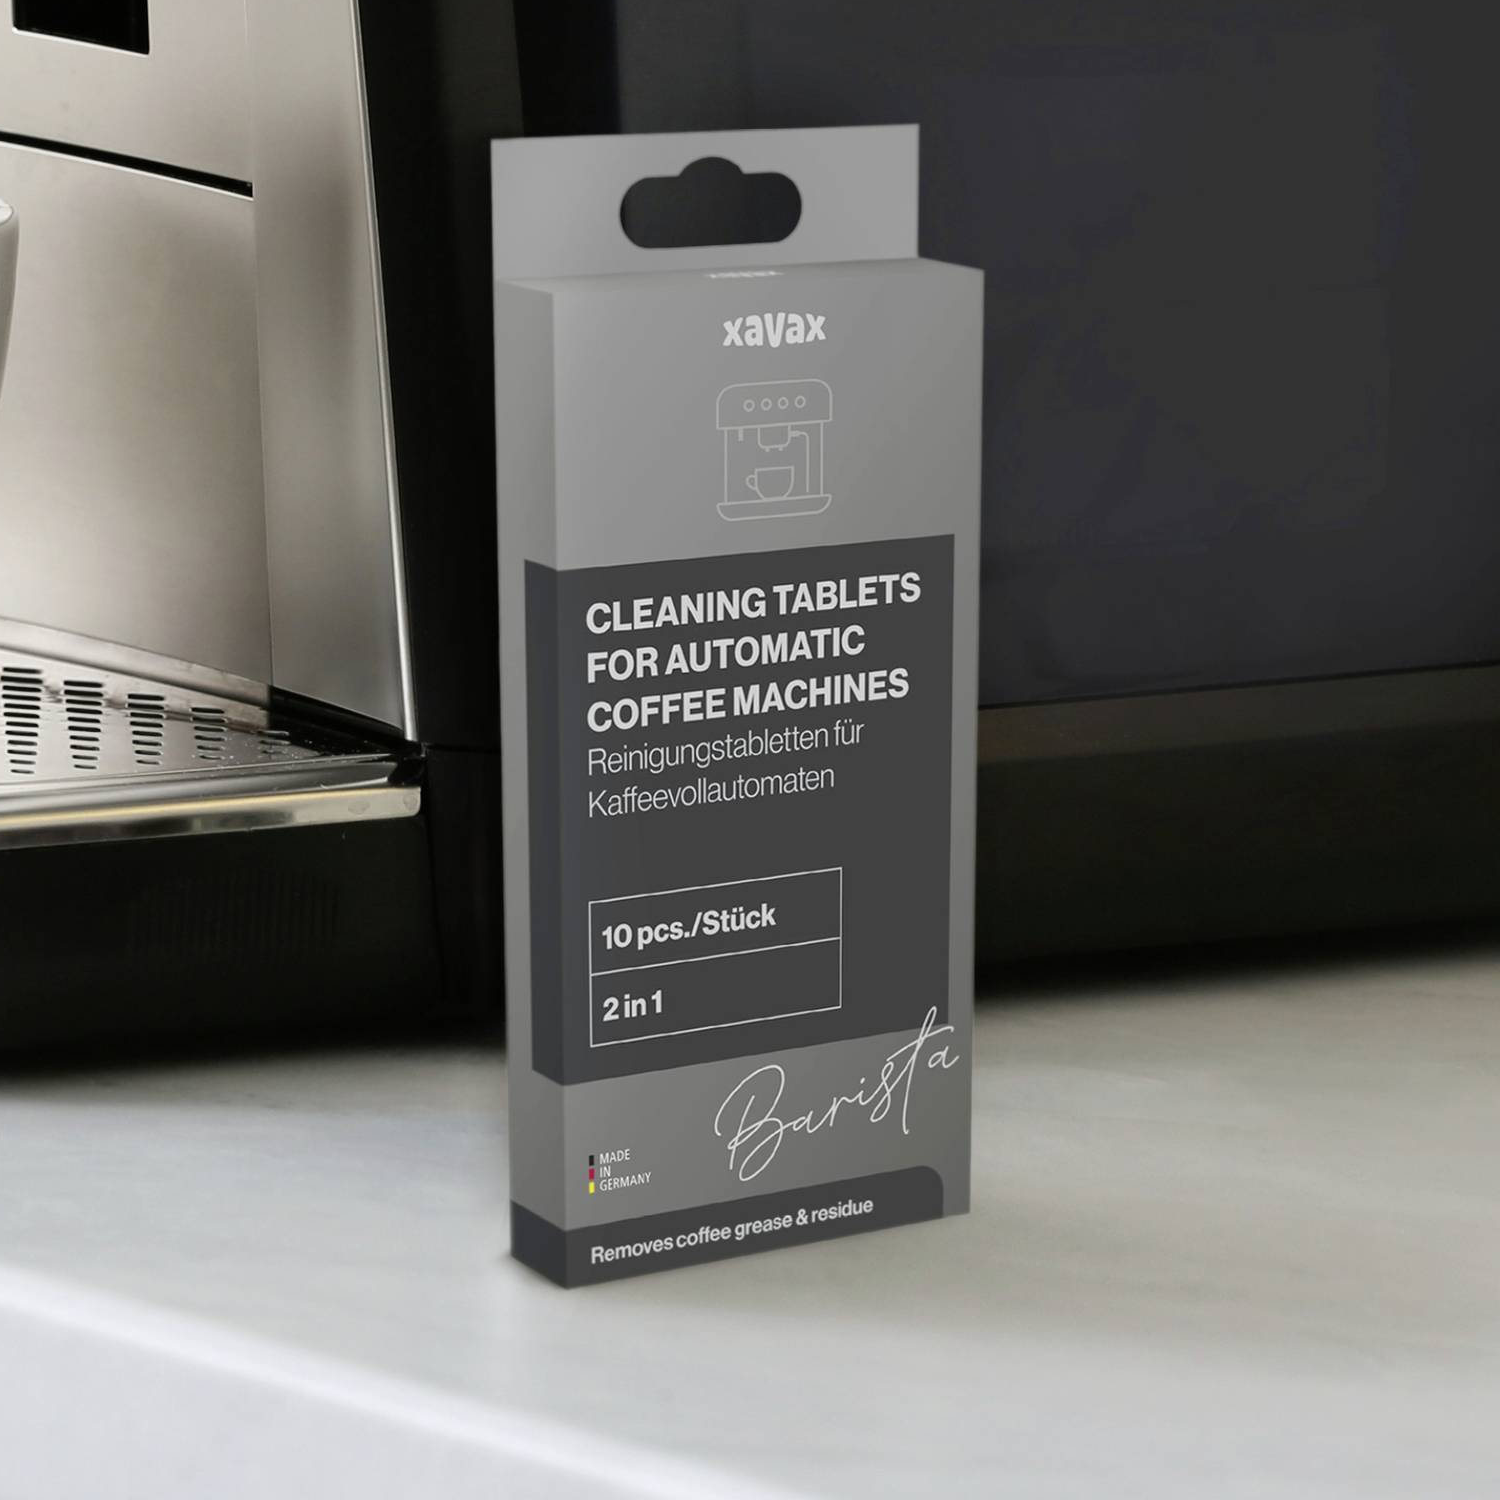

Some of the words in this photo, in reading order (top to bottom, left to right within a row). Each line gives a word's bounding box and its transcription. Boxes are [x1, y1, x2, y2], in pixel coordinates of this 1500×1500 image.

[586, 587, 767, 634] CLEANING
[772, 571, 922, 616] TABLETS
[587, 646, 658, 684] FOR
[664, 624, 866, 675] AUTOMATIC
[586, 687, 726, 733] COFFEE
[733, 667, 910, 717] MACHINES
[587, 724, 829, 776] Reinigungstabletten
[833, 718, 865, 747] für
[587, 766, 835, 818] Kaffeevollautomaten
[601, 923, 633, 950] 10
[637, 903, 777, 950] pcs./Stück
[602, 996, 620, 1022] 2
[623, 993, 647, 1018] in
[651, 989, 663, 1014] 1
[714, 1006, 960, 1182] Barista
[599, 1148, 631, 1165] MADE
[599, 1164, 611, 1179] IN
[599, 1171, 652, 1192] GERMANY
[591, 1235, 673, 1264] Removes
[676, 1226, 732, 1249] coffee
[734, 1212, 793, 1241] grease
[795, 1208, 809, 1226] &
[810, 1199, 874, 1223] residue
